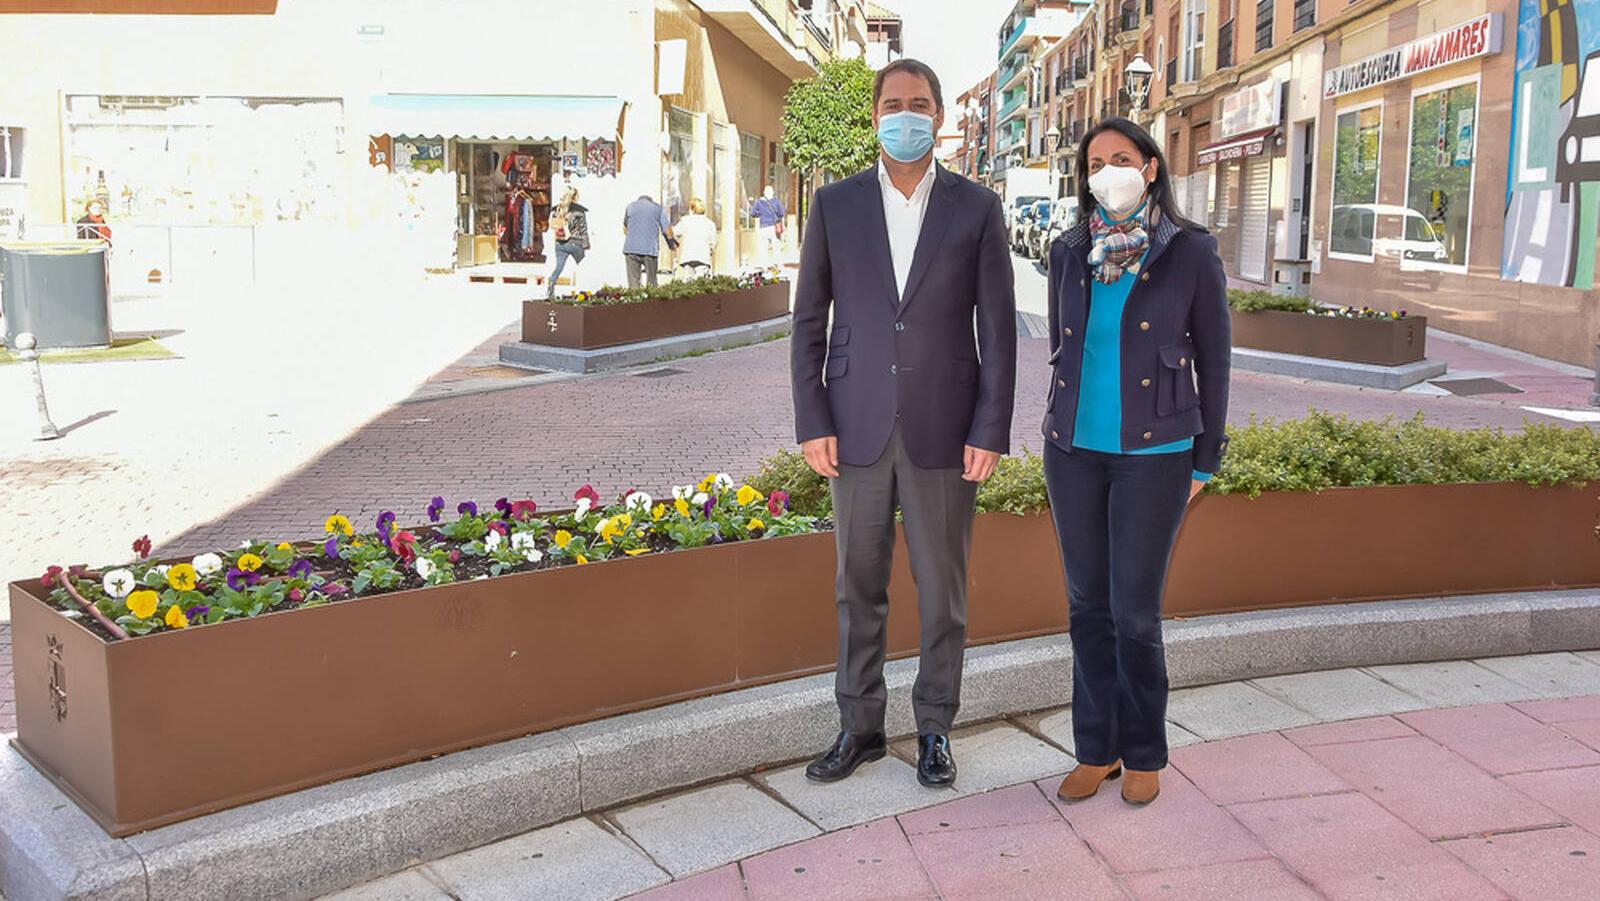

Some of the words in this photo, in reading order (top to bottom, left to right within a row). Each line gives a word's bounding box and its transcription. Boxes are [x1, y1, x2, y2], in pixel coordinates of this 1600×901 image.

[1338, 51, 1401, 93] AUTOESCUELA
[1404, 18, 1489, 74] MANZANARES
[1518, 80, 1548, 183] L
